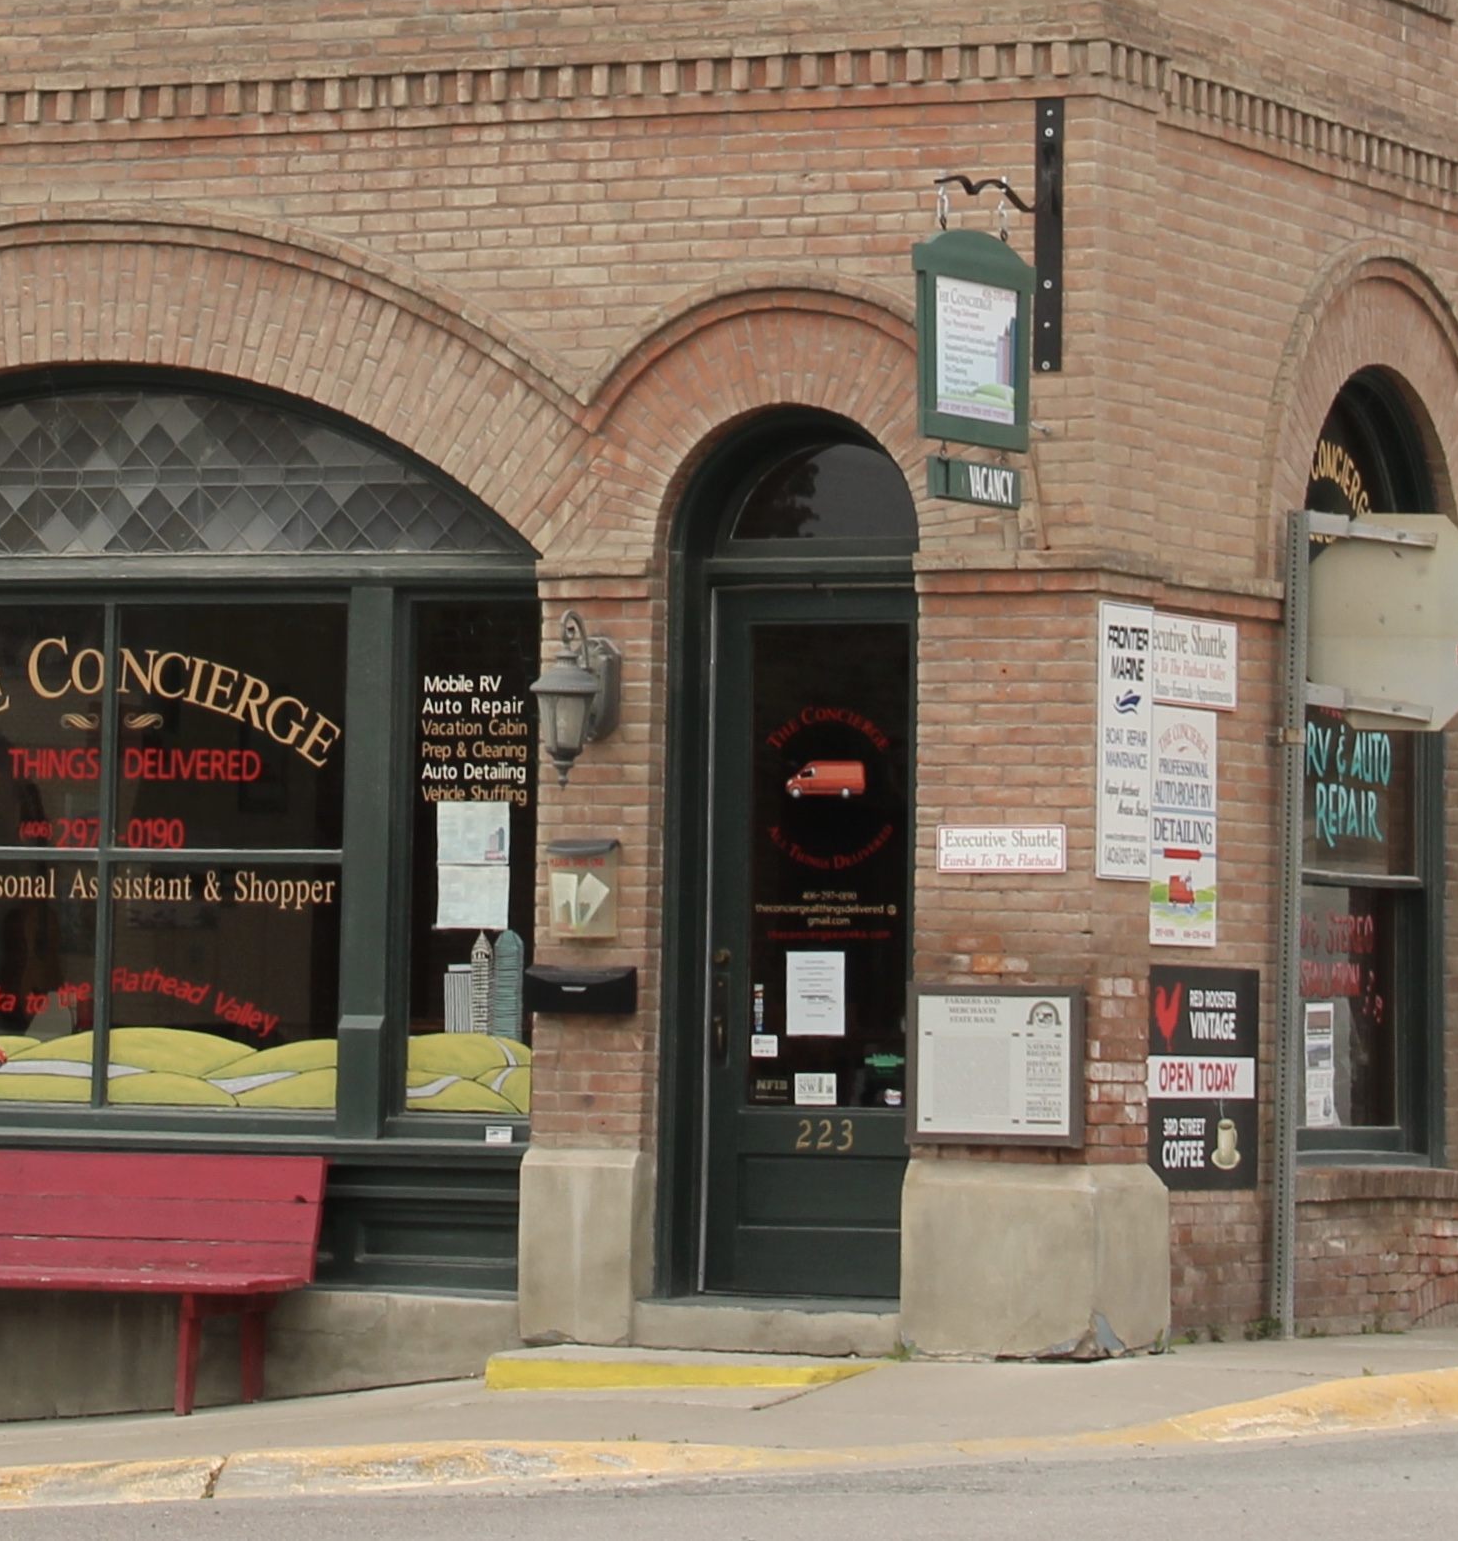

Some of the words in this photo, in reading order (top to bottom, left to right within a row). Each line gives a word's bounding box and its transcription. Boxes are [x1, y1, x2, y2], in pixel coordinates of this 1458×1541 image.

[969, 465, 1013, 504] VACANCY
[1108, 625, 1149, 651] FRONTIER
[1152, 622, 1188, 655] ecutive
[1191, 624, 1228, 659] Shuttle
[1110, 655, 1144, 682] MARINE
[424, 675, 474, 693] Mobile
[480, 675, 501, 693] RV
[28, 636, 341, 768] CONCIERGE
[422, 698, 463, 714] Auto
[471, 697, 524, 718] Repair
[422, 719, 482, 736] Vacation
[488, 719, 528, 736] Cabin
[766, 718, 800, 749] THE
[801, 706, 890, 752] CONCIERGE
[1105, 727, 1124, 744] BOAT
[1127, 729, 1147, 747] REPAIR
[422, 741, 451, 761] Prep
[456, 741, 466, 758] &
[472, 741, 527, 762] Cleaning
[1306, 721, 1333, 778] RV
[1350, 731, 1391, 786] AUTO
[8, 749, 100, 780] THINGS
[124, 749, 261, 782] DELIVERED
[422, 763, 458, 780] Auto
[464, 763, 526, 783] Detailing
[1159, 757, 1209, 779] PROFESSIONAL
[422, 785, 465, 801] Vehicle
[471, 785, 528, 806] Shuffling
[1315, 782, 1384, 847] REPAIR
[19, 820, 53, 841] (406)
[945, 830, 1007, 848] Executive
[1011, 830, 1059, 848] Shuttle
[1153, 817, 1213, 845] DETAILING
[789, 842, 831, 869] THINGS
[833, 824, 894, 869] DELIVERED
[944, 853, 976, 867] Eureka
[981, 853, 992, 866] To
[996, 853, 1014, 867] The
[1017, 853, 1058, 867] Flathead
[70, 867, 192, 902] Assistant
[204, 871, 222, 901] &
[234, 870, 336, 910] Shopper
[807, 916, 851, 927] gmail.com
[1325, 910, 1374, 954] STEREO
[1299, 961, 1361, 998] STALLATION
[25, 991, 48, 1014] to
[58, 980, 91, 1008] the
[111, 967, 209, 1004] Flathead
[213, 991, 280, 1038] Valley
[1189, 989, 1204, 1007] RED
[1205, 990, 1237, 1008] ROOSTER
[1189, 1011, 1237, 1040] VINTAGE
[756, 1079, 788, 1090] NFIB
[1158, 1061, 1194, 1092] OPEN
[1198, 1062, 1238, 1093] TODAY
[795, 1119, 853, 1150] 223
[1163, 1118, 1178, 1135] 3RD
[1179, 1118, 1206, 1136] STREET
[1162, 1140, 1205, 1169] COFFEE
